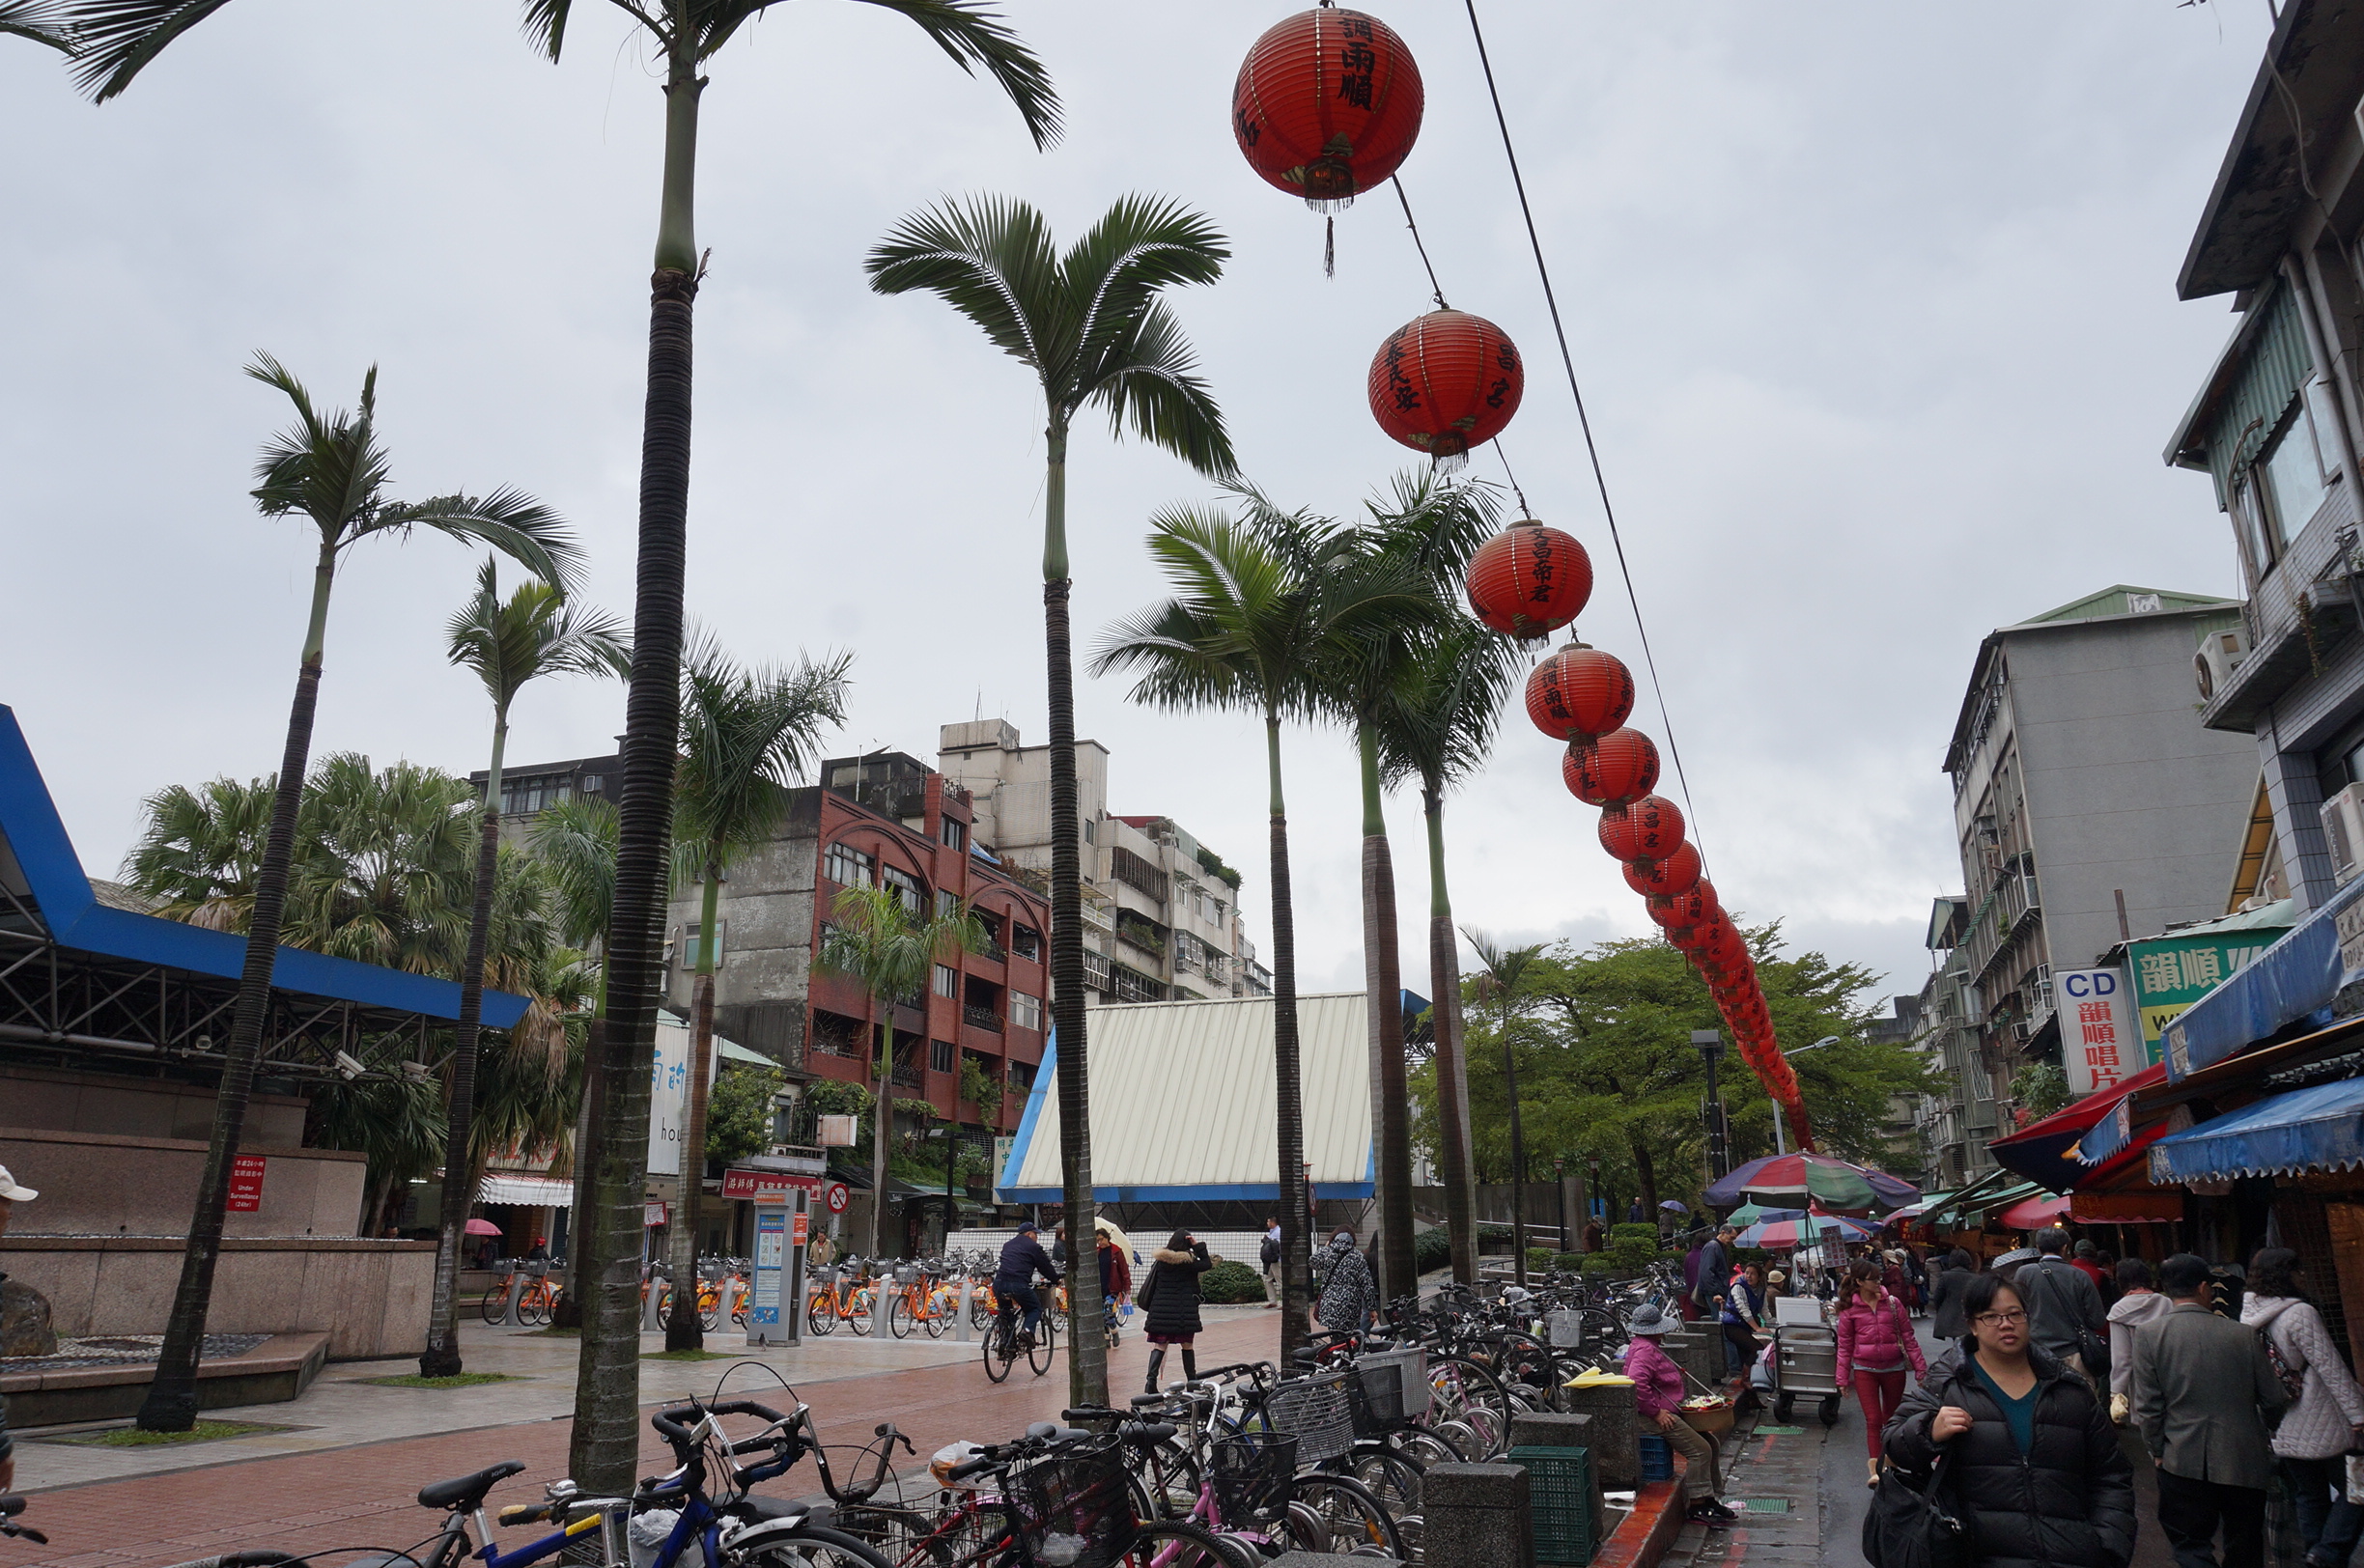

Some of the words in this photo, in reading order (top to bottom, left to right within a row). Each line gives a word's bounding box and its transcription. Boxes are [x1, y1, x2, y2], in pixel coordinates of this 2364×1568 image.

[1486, 326, 1516, 410] 昌宮
[1527, 528, 1555, 603] 文昌帝君
[1643, 798, 1661, 849] 文昌宮
[2066, 972, 2116, 997] CD
[2139, 946, 2224, 994] 韻順
[2076, 1000, 2123, 1090] 韻順唱片
